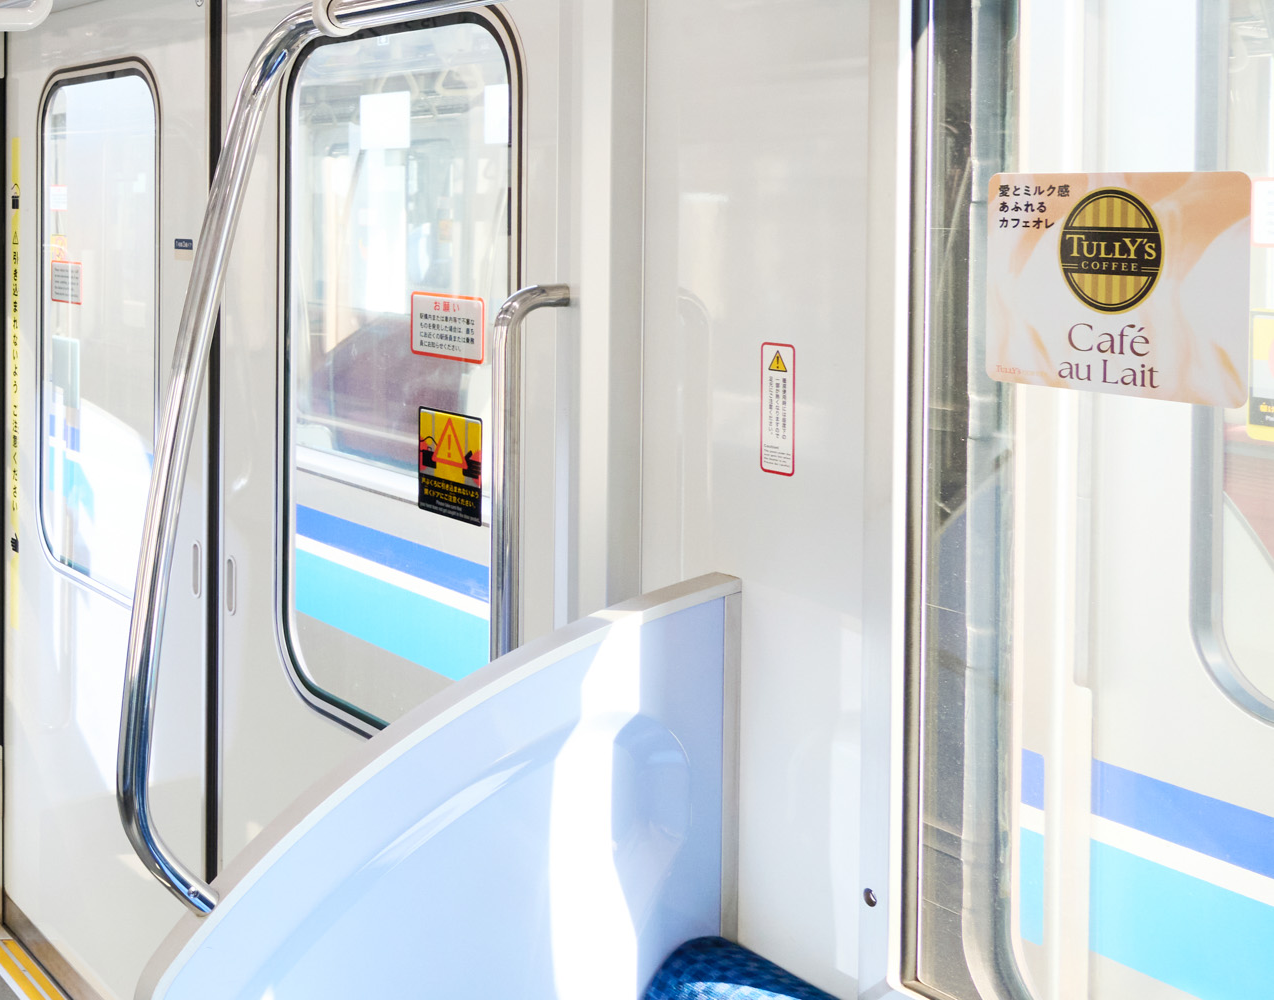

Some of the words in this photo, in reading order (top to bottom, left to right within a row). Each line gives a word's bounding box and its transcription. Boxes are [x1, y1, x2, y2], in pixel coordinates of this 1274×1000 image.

[998, 184, 1070, 198] 愛とミルク感
[998, 200, 1047, 214] あふれる
[998, 217, 1055, 231] カフェオレ
[1065, 234, 1156, 261] TULLY'S
[1081, 260, 1139, 273] COFFEE
[434, 301, 460, 312] お願い
[1067, 322, 1150, 357] Café
[1058, 361, 1092, 383] au
[1100, 358, 1160, 389] Lait
